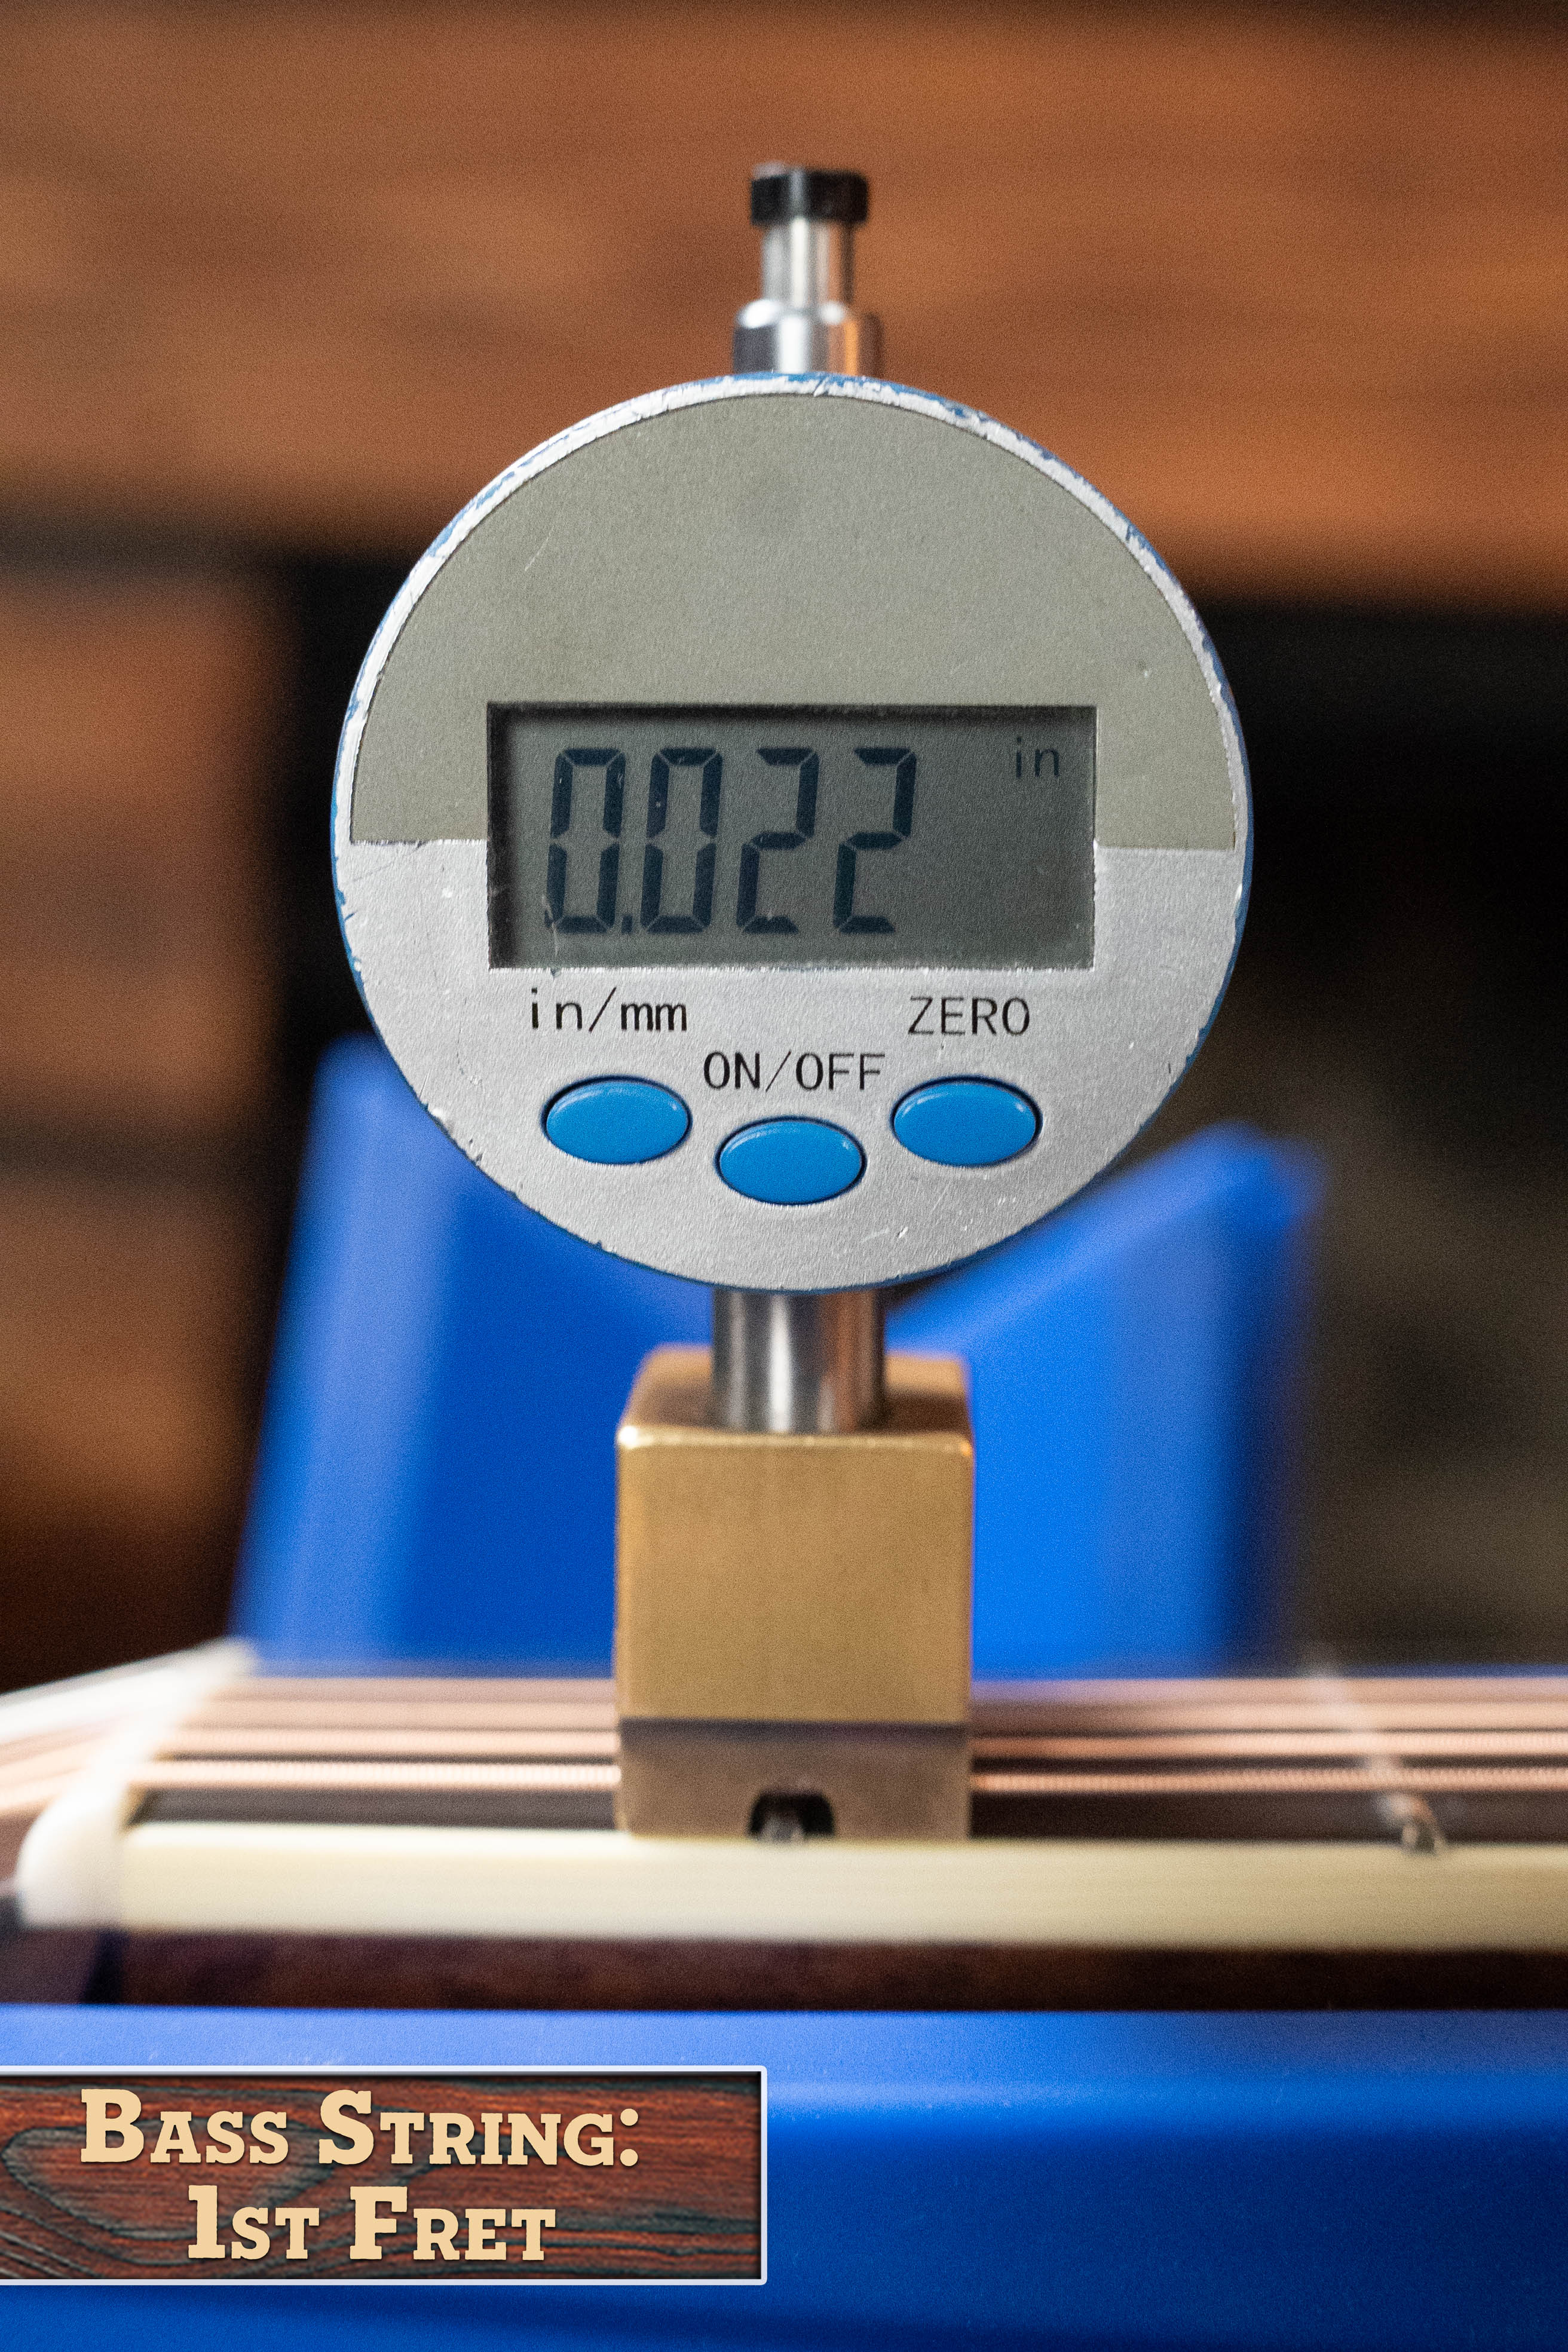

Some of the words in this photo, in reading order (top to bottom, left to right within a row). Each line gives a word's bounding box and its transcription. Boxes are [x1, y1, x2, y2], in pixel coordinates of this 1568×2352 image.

[1014, 736, 1060, 779] in
[546, 748, 917, 934] 0.022
[531, 987, 688, 1033] in/mm
[907, 996, 1031, 1037] ZERO
[702, 1050, 886, 1092] ON/OFF
